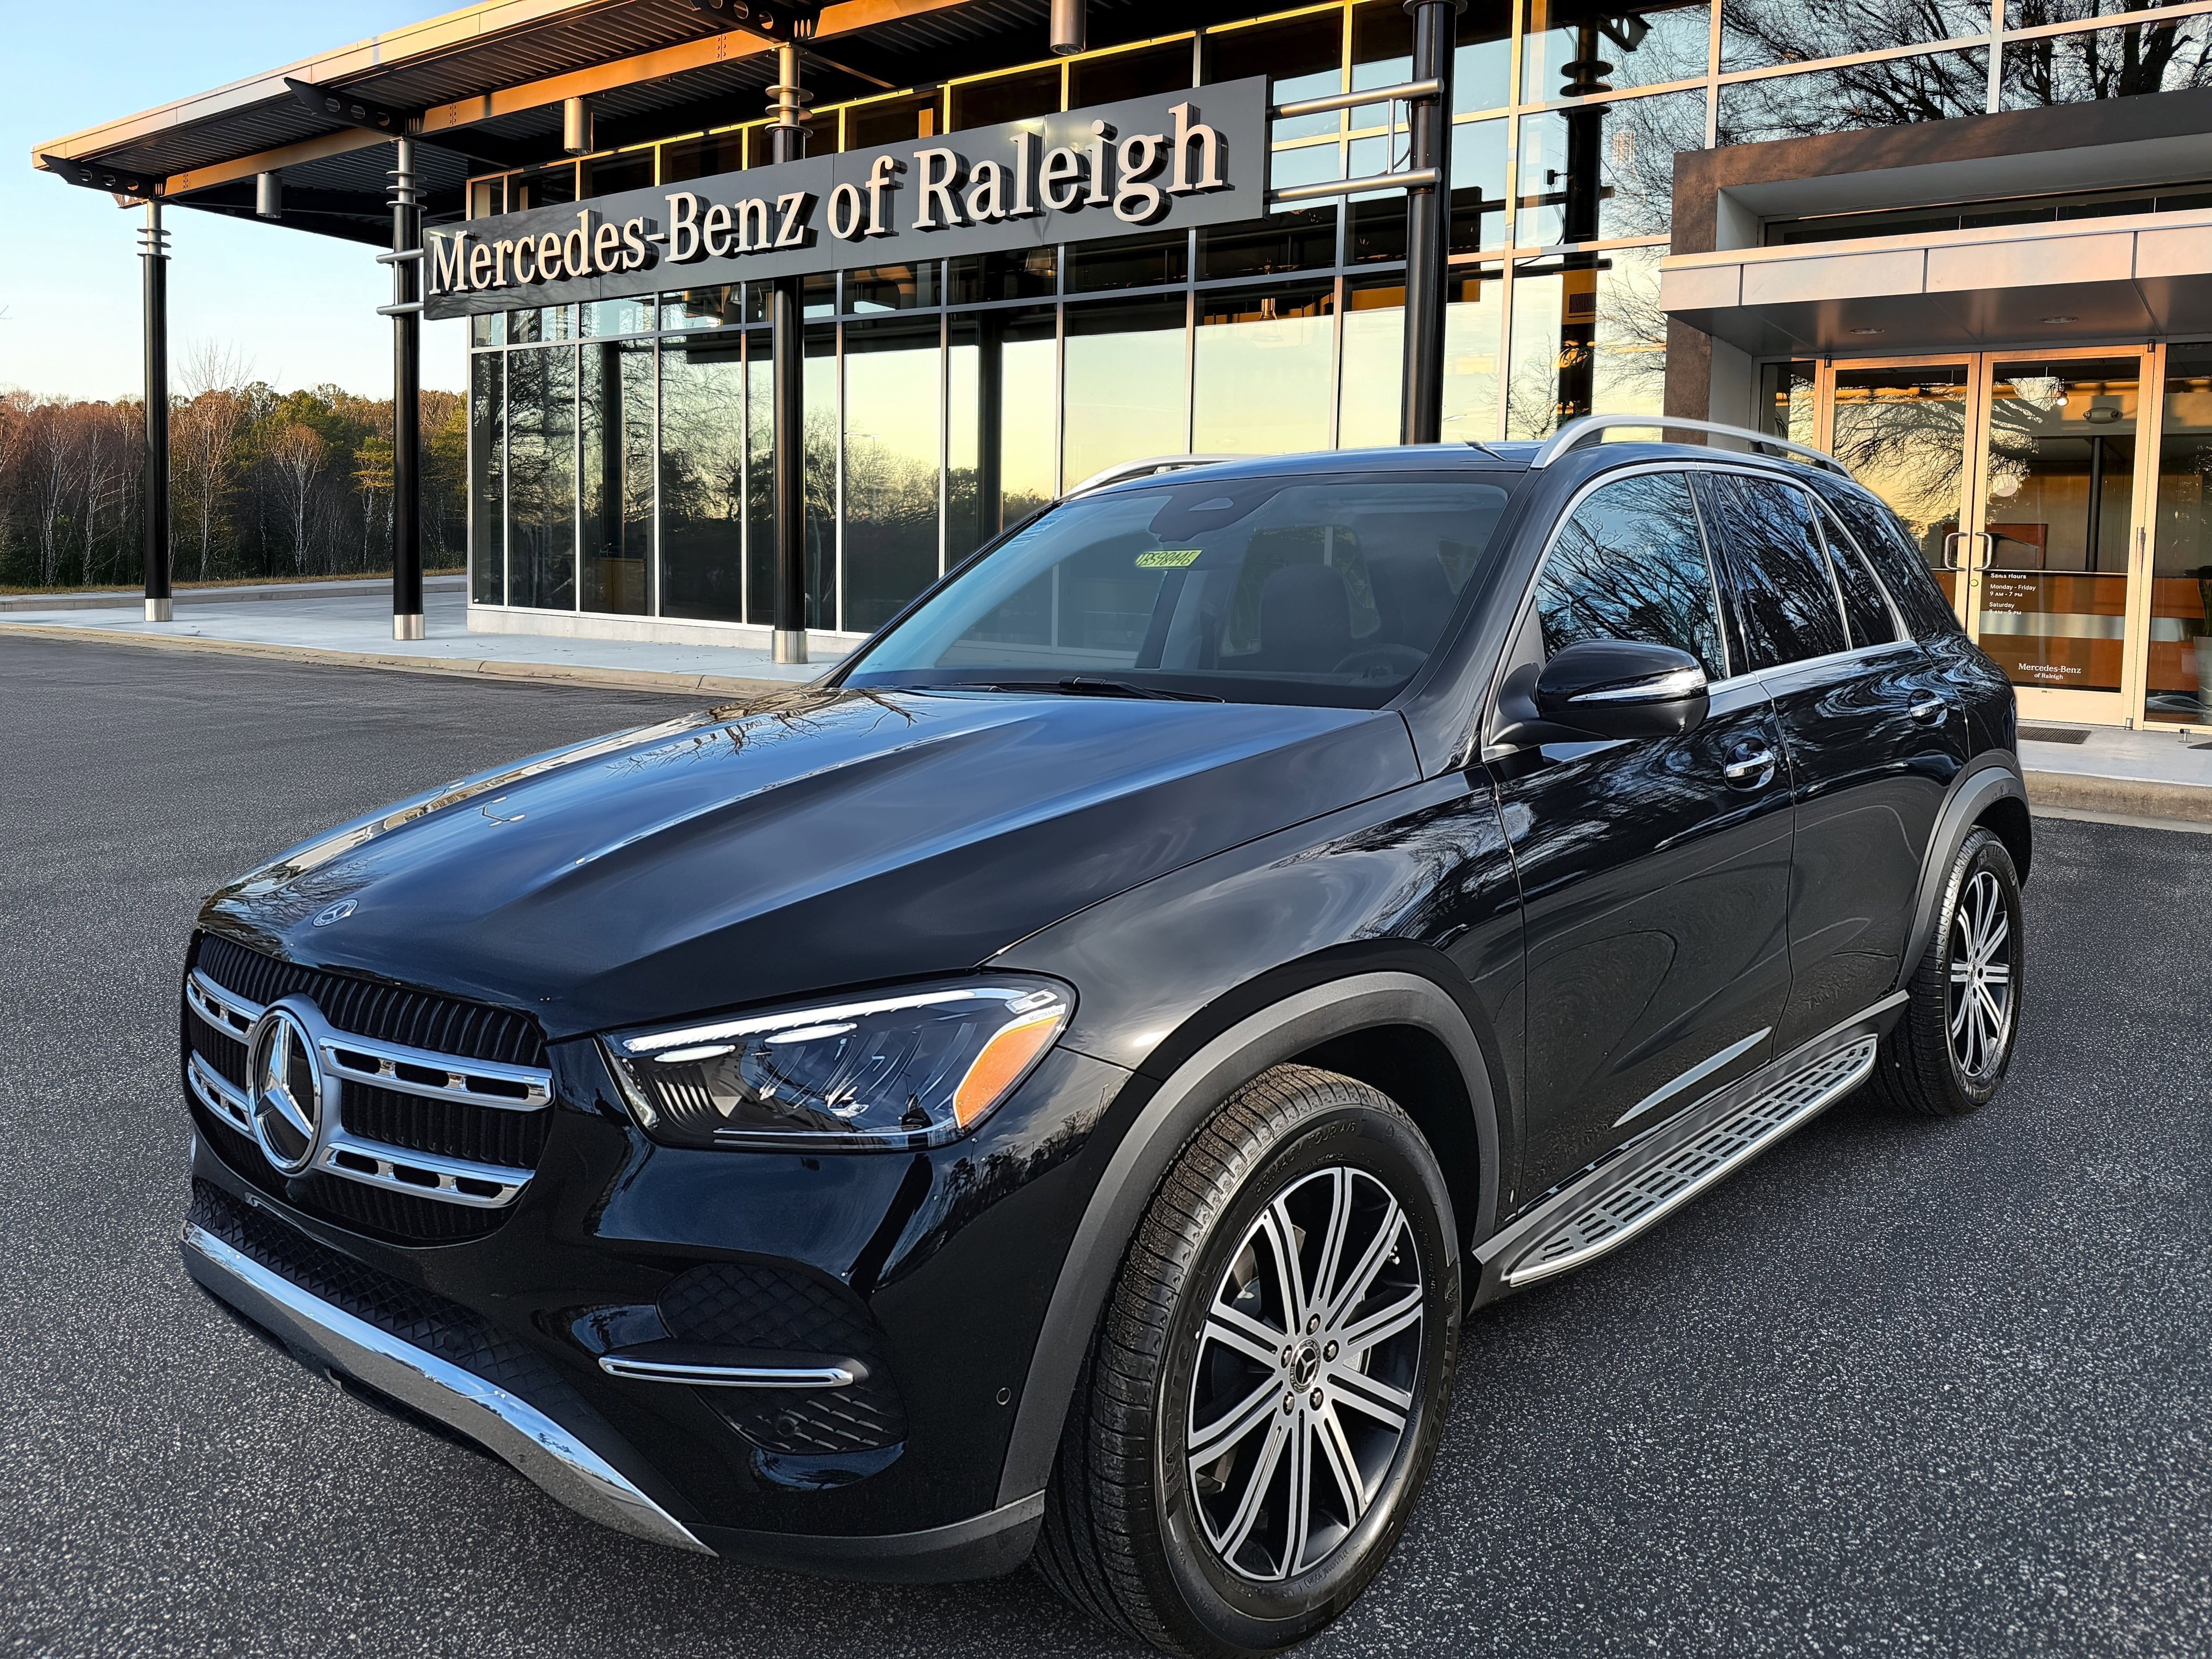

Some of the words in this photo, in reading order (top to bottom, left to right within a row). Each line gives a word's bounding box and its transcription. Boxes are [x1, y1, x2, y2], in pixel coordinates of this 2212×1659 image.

[429, 191, 805, 295] Mercedes-Benz
[827, 155, 894, 239] of
[912, 101, 1224, 229] Raleigh
[2018, 663, 2081, 674] Mercedes-Benz
